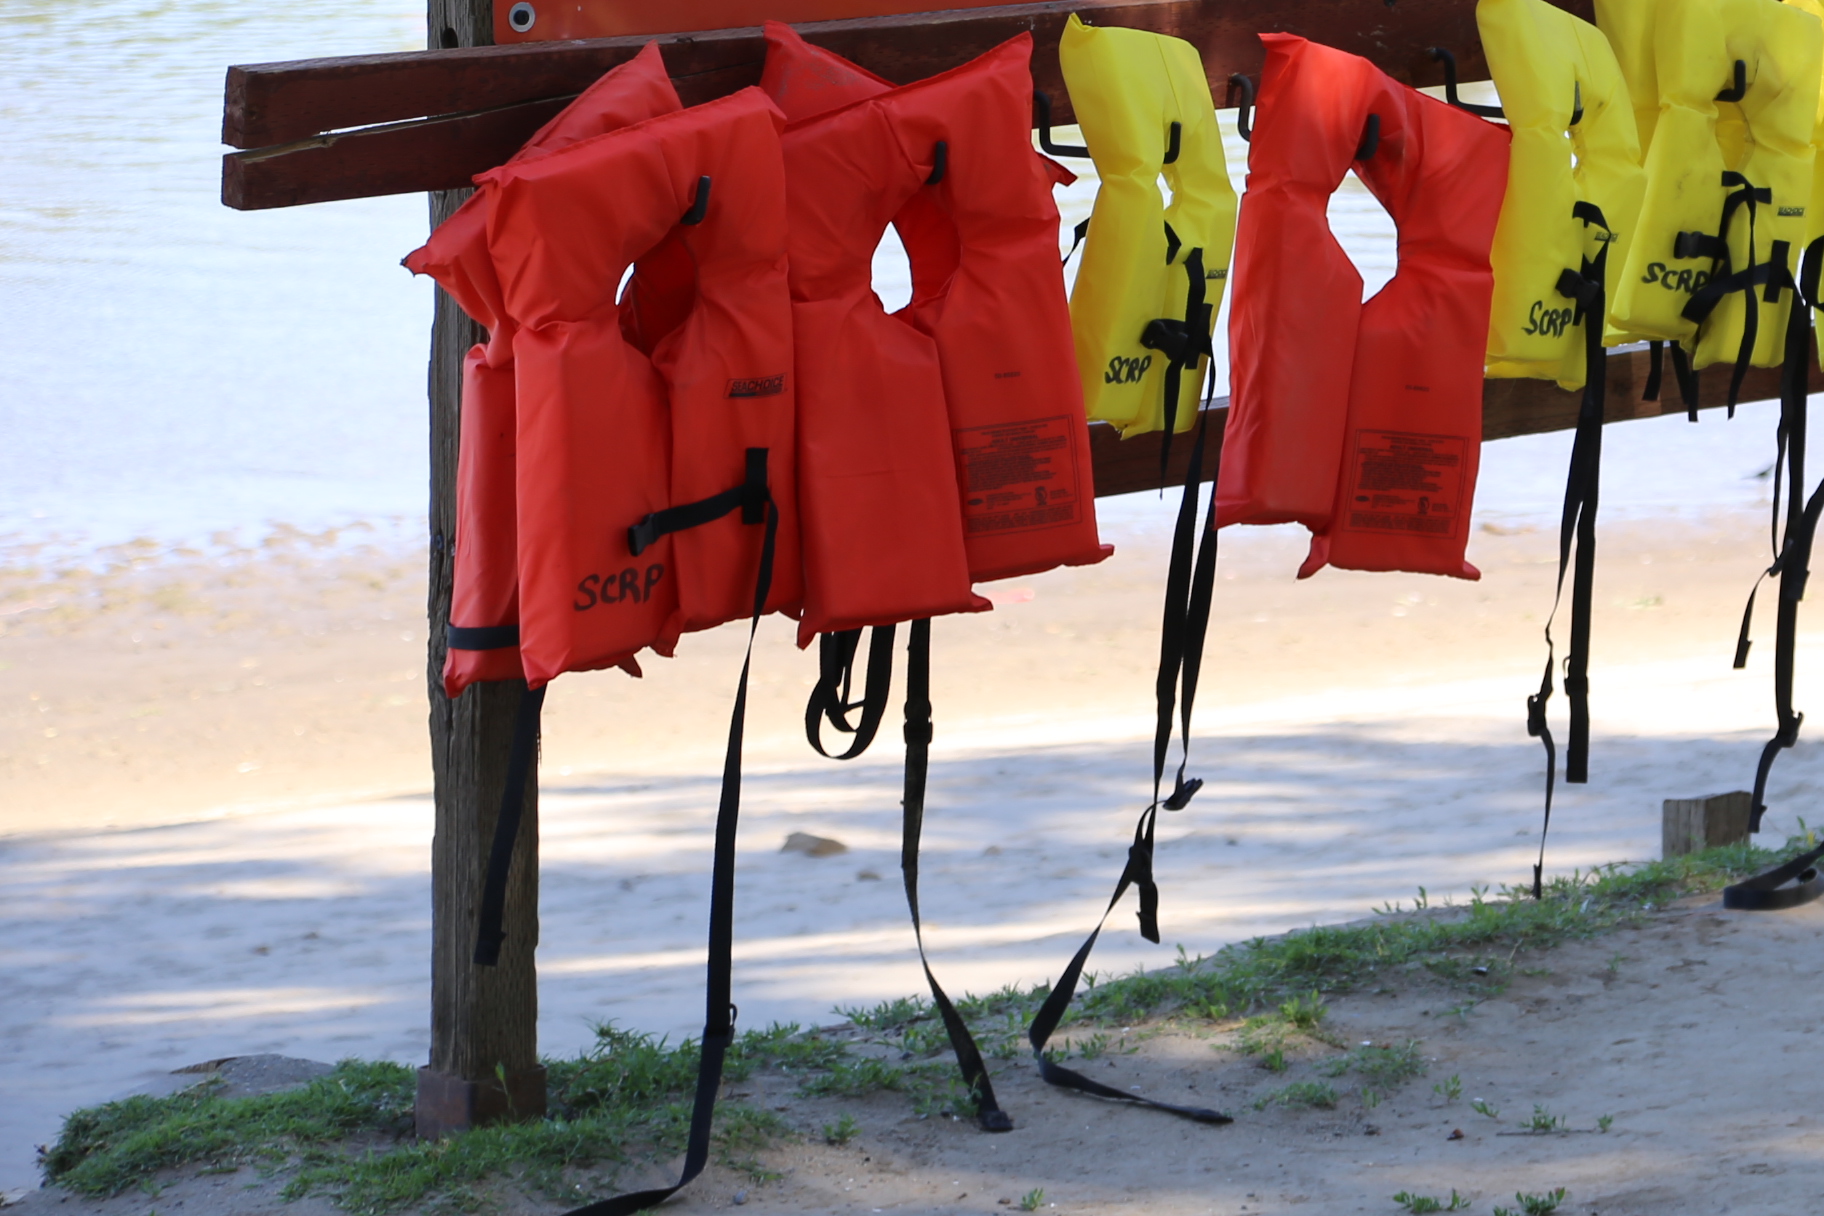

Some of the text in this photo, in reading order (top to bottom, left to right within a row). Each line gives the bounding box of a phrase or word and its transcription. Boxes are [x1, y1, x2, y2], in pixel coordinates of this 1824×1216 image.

[1641, 262, 1711, 297] SCRP
[1521, 300, 1573, 339] SCRP
[1104, 354, 1152, 384] SCRP
[573, 563, 665, 612] SCRP
